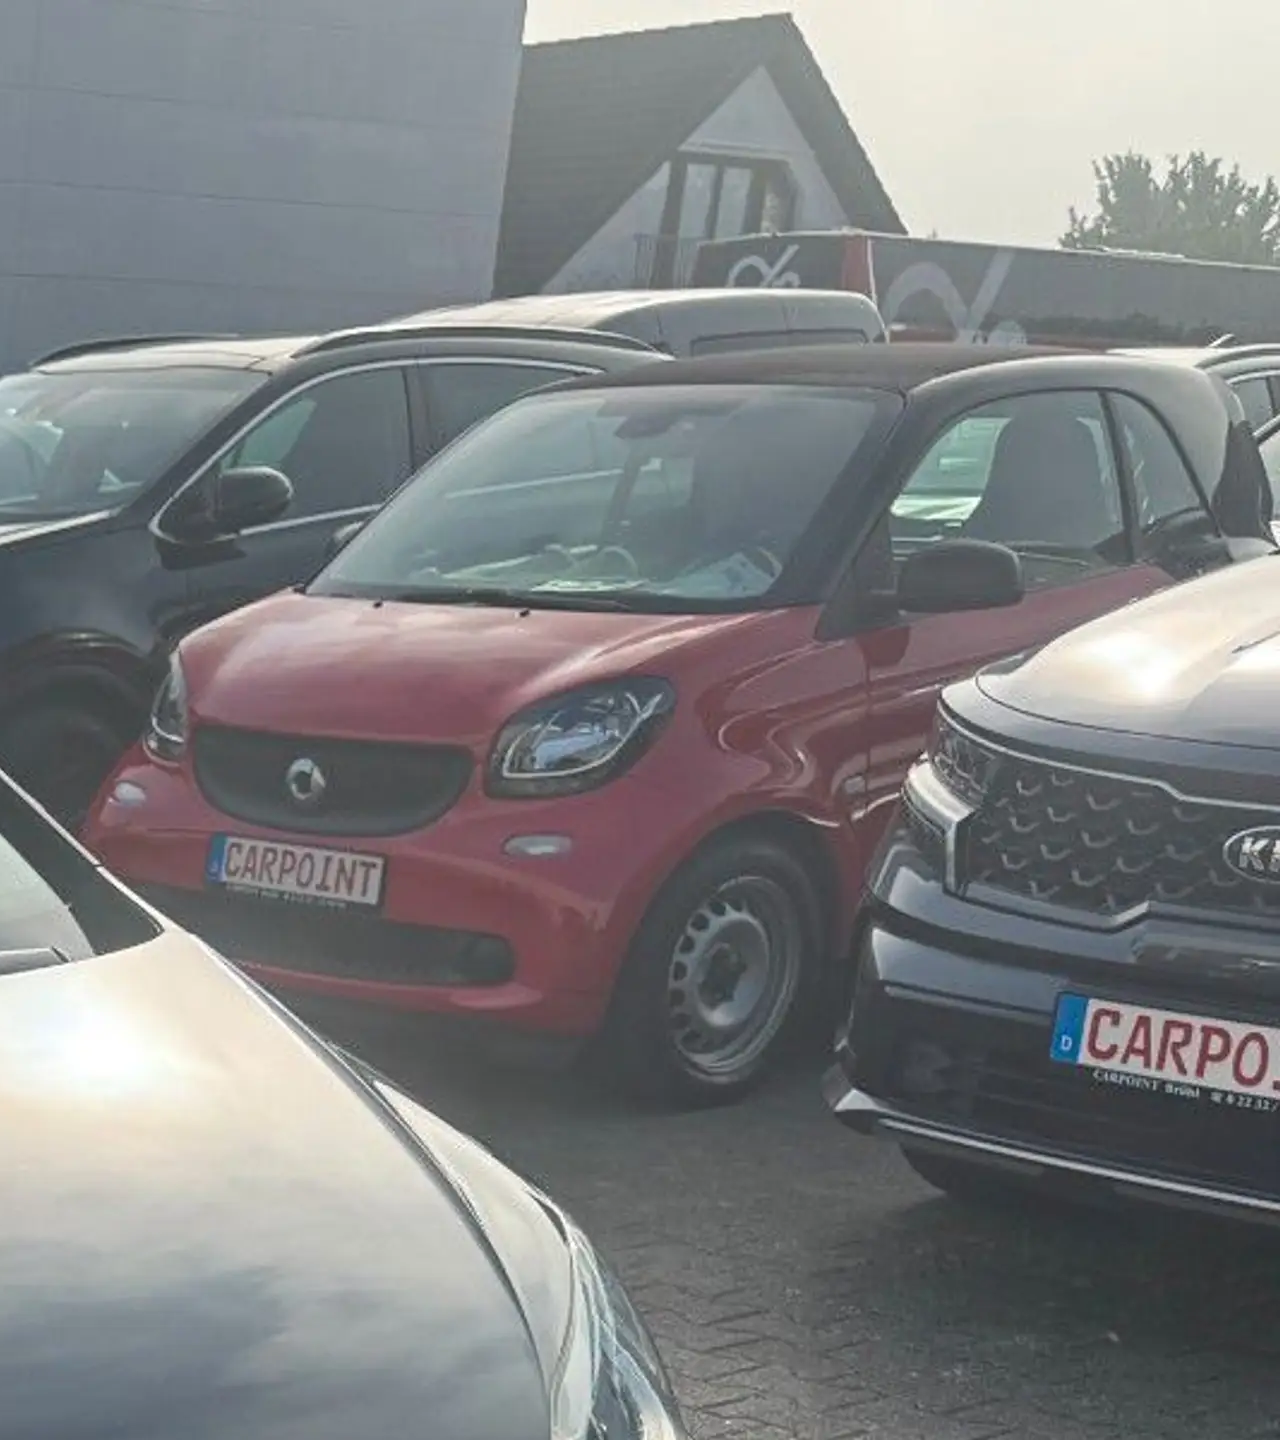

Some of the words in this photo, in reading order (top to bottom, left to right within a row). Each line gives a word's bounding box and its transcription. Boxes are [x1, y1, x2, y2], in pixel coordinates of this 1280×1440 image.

[226, 843, 377, 897] CARPOINT
[1060, 1034, 1073, 1051] D
[1088, 1007, 1280, 1090] CARPO
